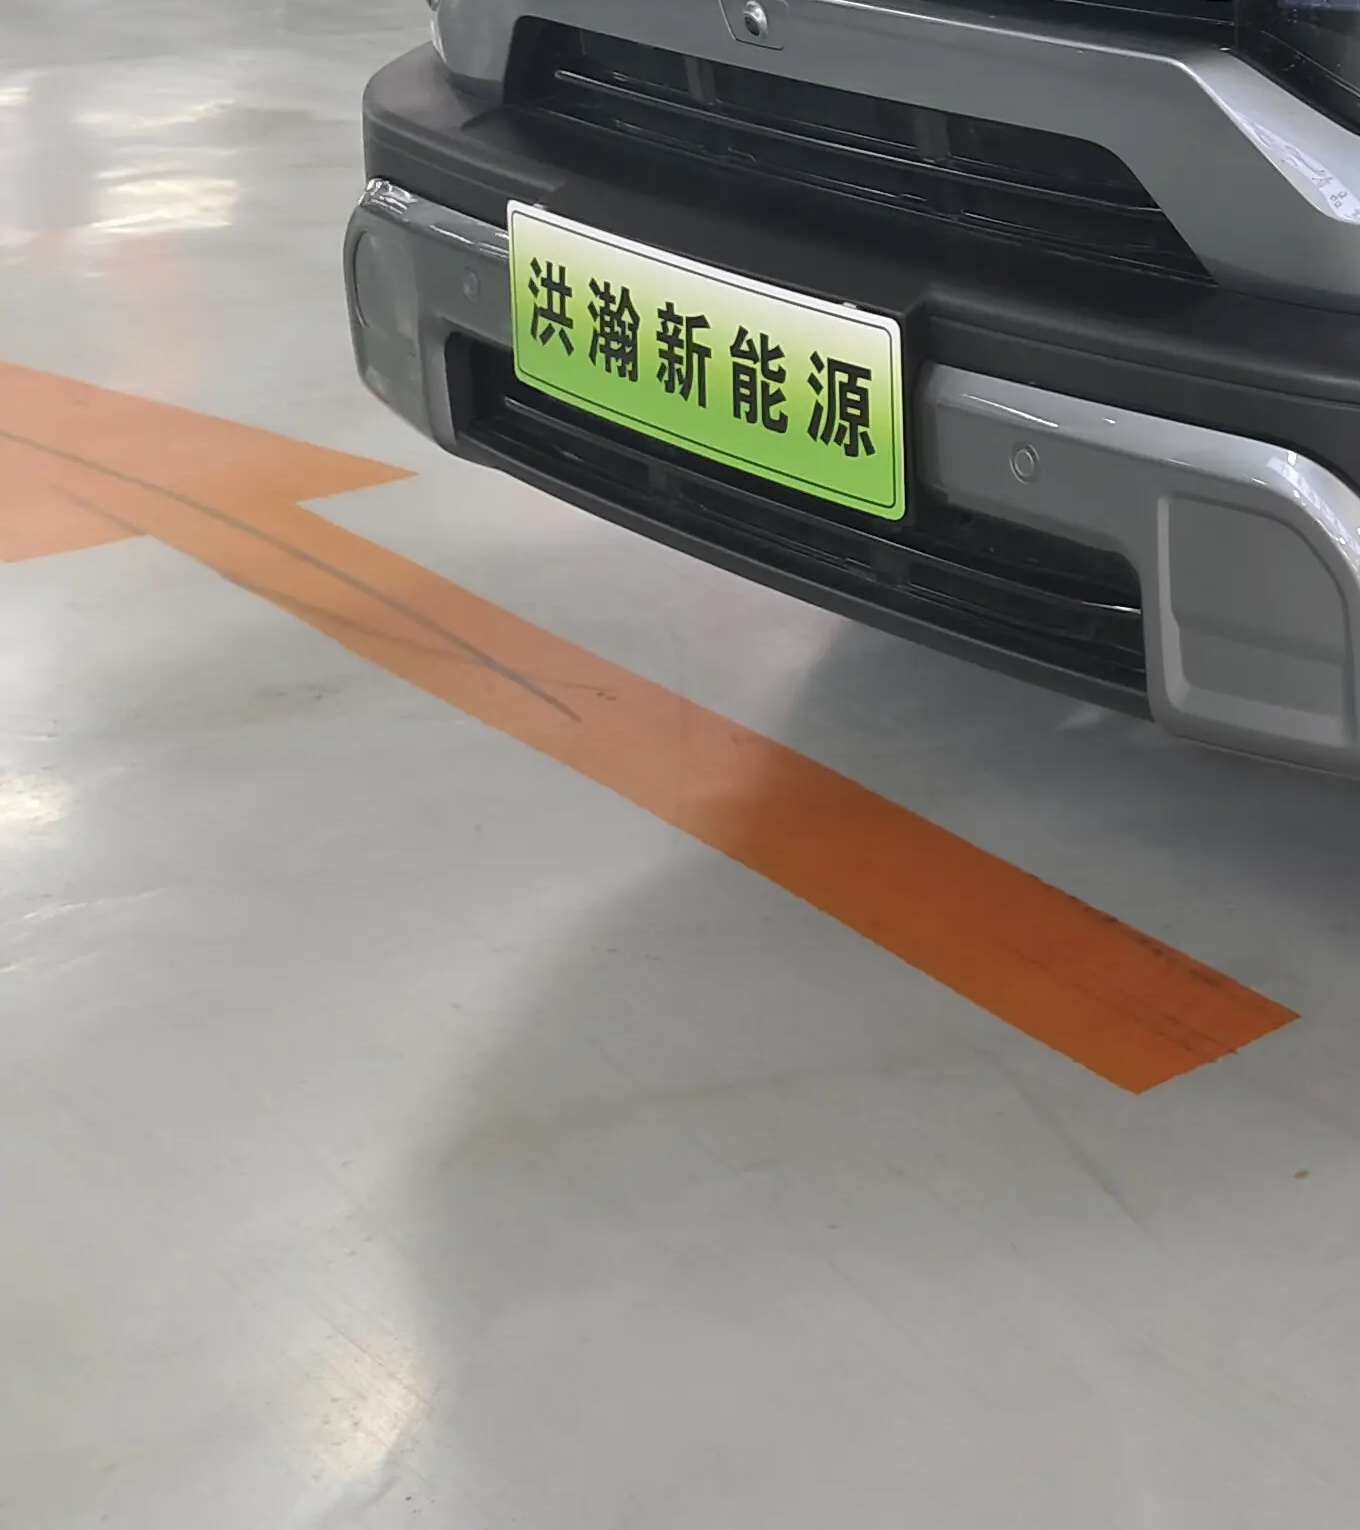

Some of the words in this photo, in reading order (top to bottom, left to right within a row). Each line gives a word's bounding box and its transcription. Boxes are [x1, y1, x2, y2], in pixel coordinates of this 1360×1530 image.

[528, 256, 876, 458] 洪瀚新能源
